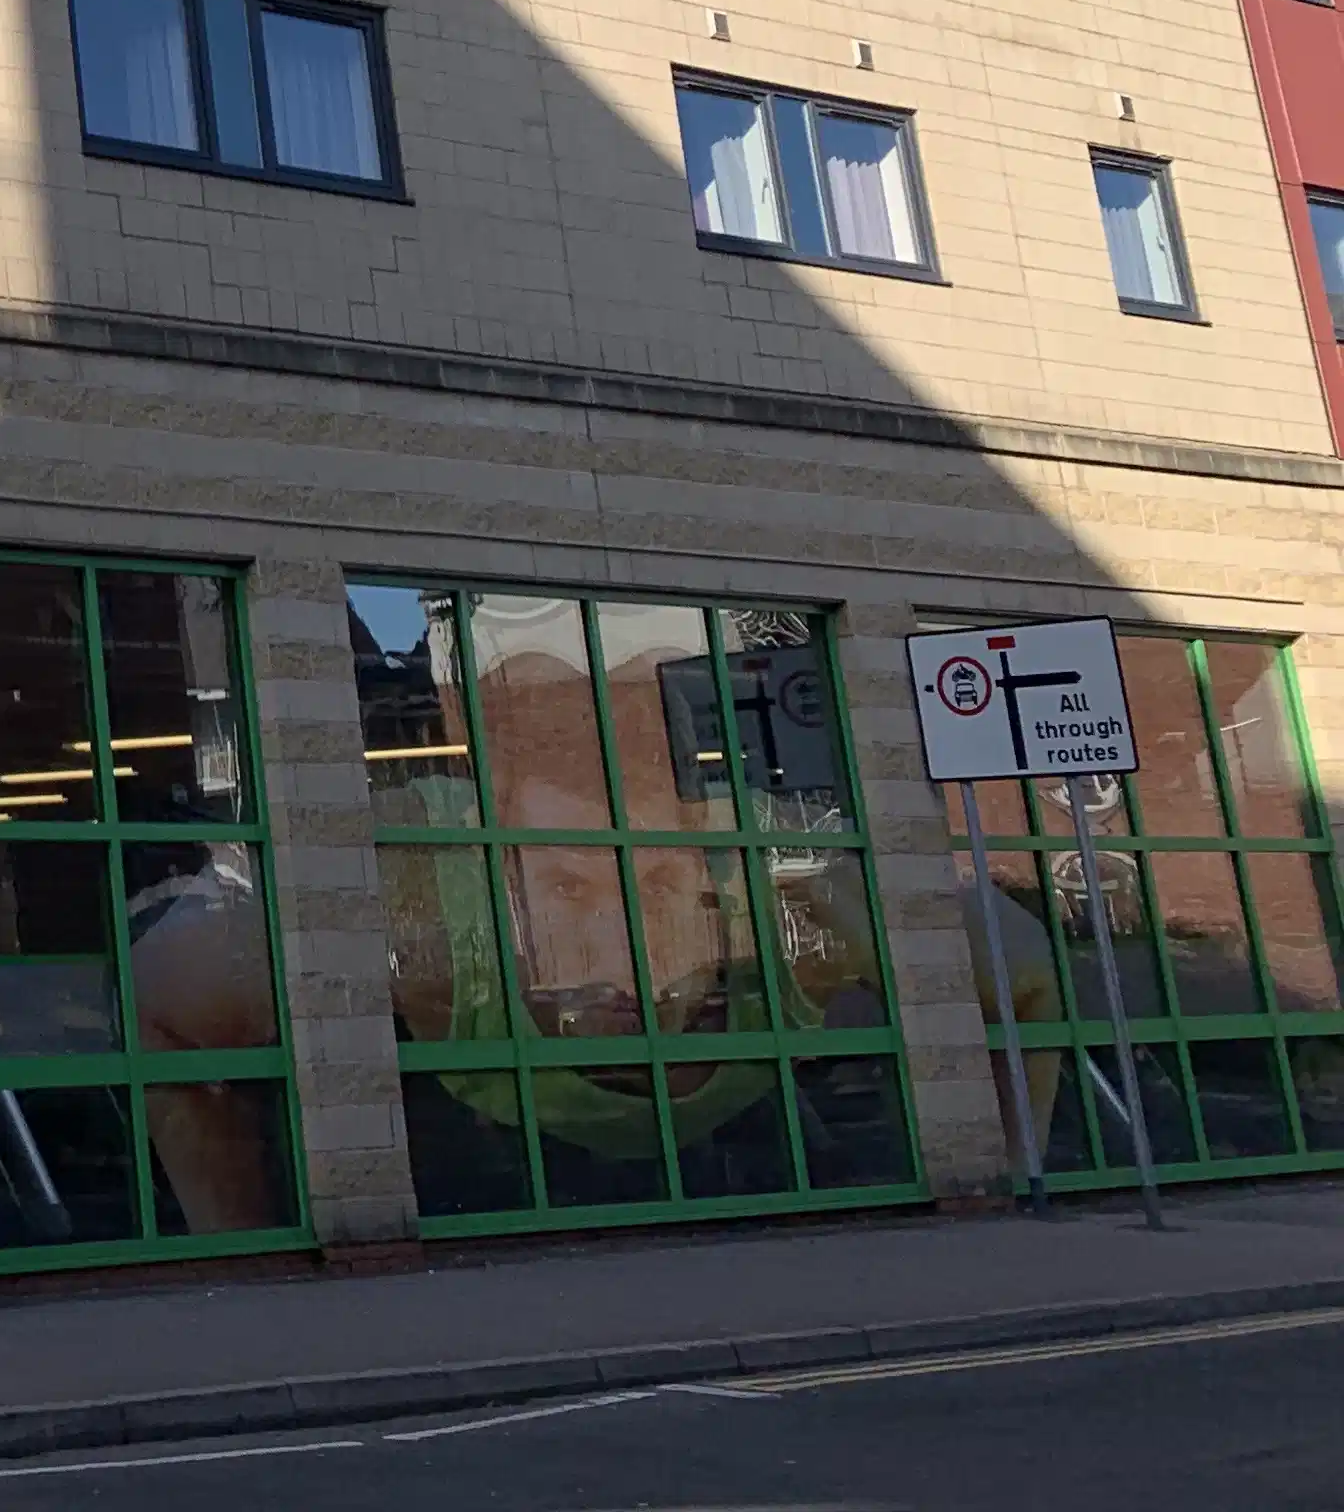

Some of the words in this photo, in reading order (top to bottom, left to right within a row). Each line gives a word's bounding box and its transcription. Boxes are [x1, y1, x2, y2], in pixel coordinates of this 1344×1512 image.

[1060, 693, 1091, 713] All
[1035, 716, 1123, 739] through
[1047, 743, 1119, 764] routes
